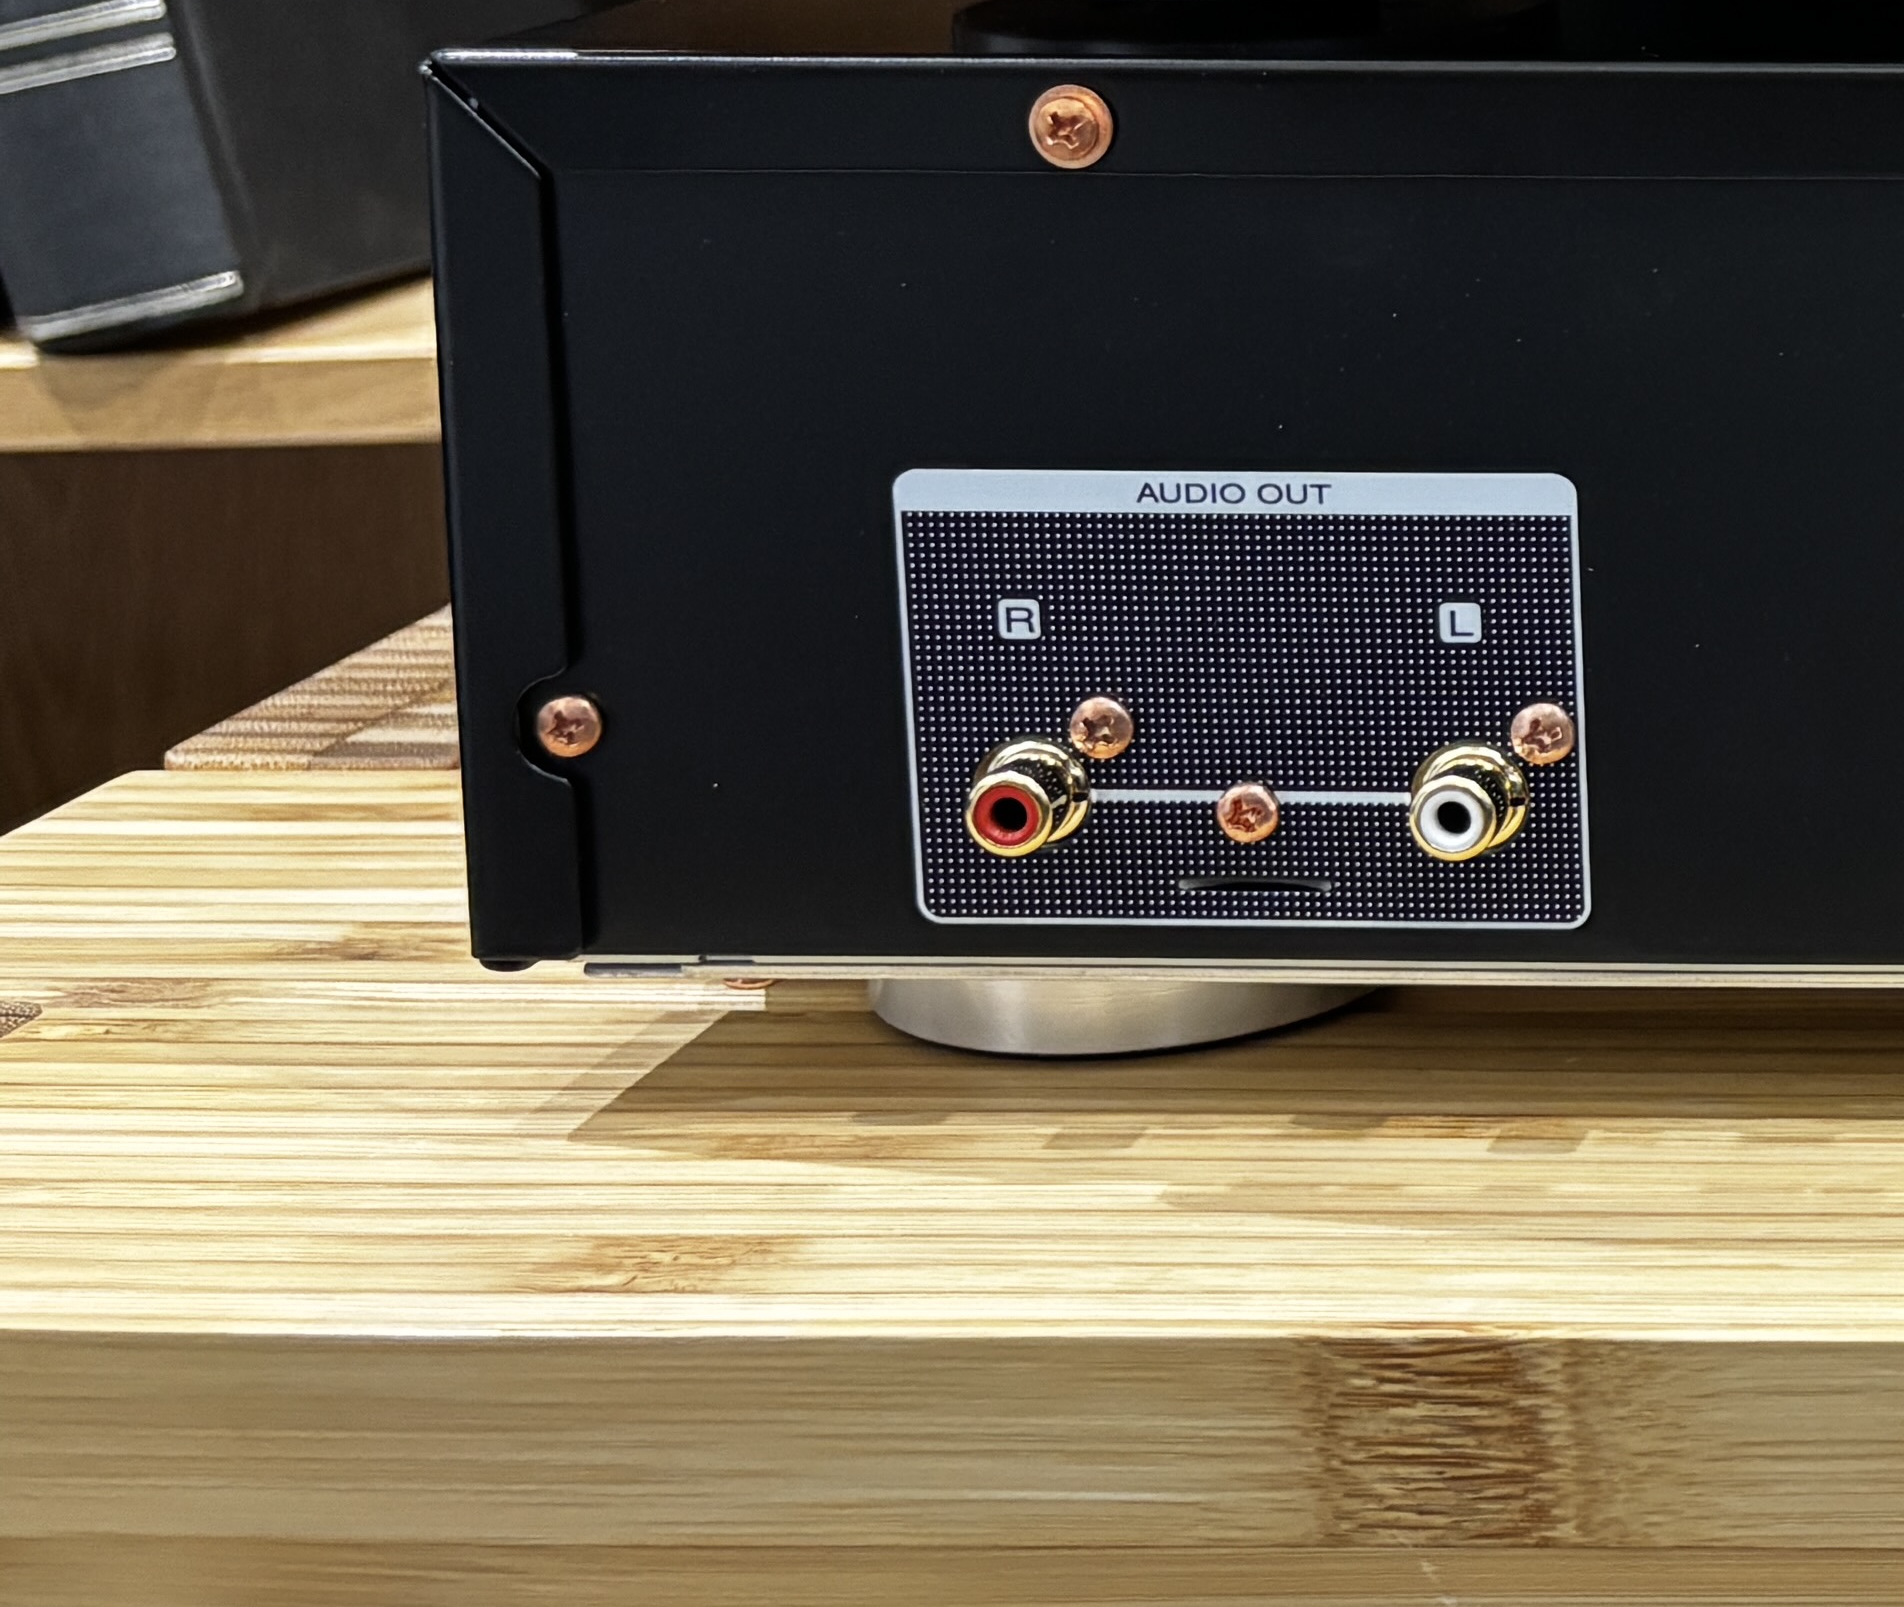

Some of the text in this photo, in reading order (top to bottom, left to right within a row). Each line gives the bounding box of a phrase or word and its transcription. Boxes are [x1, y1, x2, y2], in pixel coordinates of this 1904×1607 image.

[1137, 483, 1331, 504] AUDIO OUT
[1006, 607, 1034, 633] R
[1450, 611, 1474, 636] L
